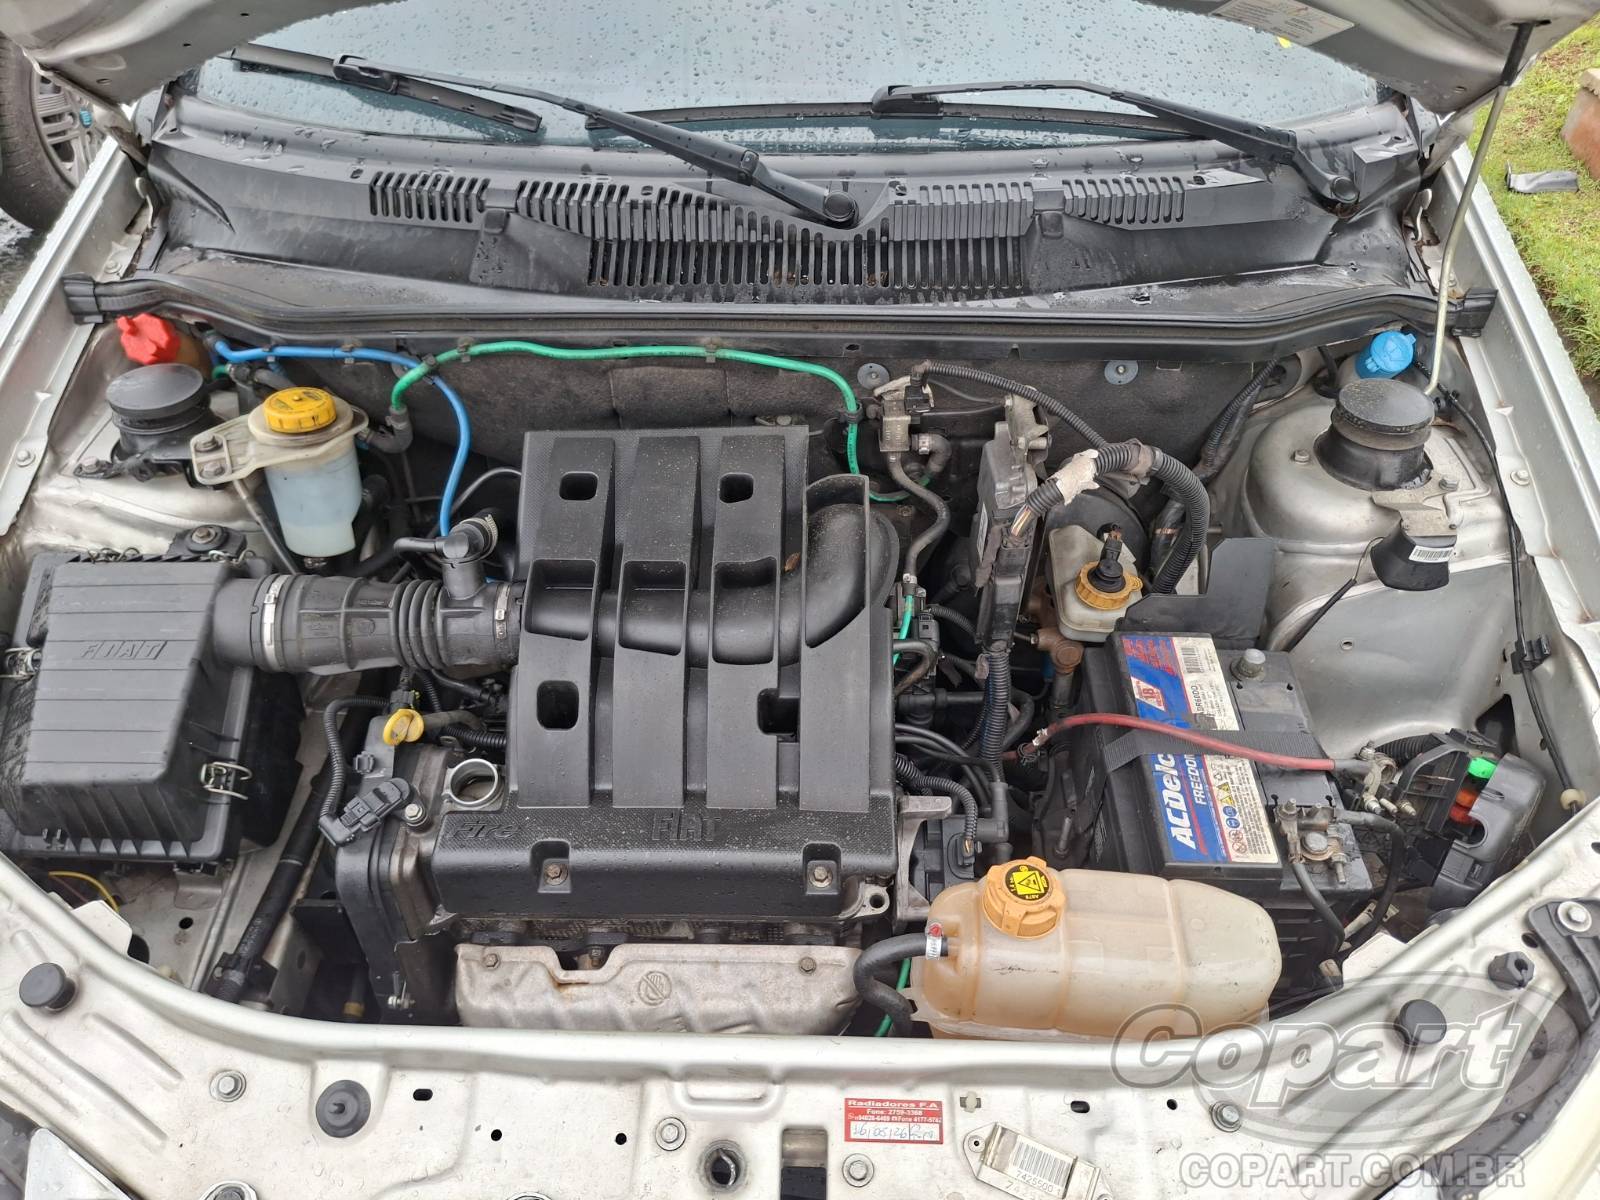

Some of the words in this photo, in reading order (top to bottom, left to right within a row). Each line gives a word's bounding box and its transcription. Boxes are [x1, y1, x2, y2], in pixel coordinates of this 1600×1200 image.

[81, 640, 168, 660] FIAT
[1155, 754, 1197, 850] ACDelc
[652, 812, 721, 841] FIAT
[848, 1099, 916, 1108] Radiadores
